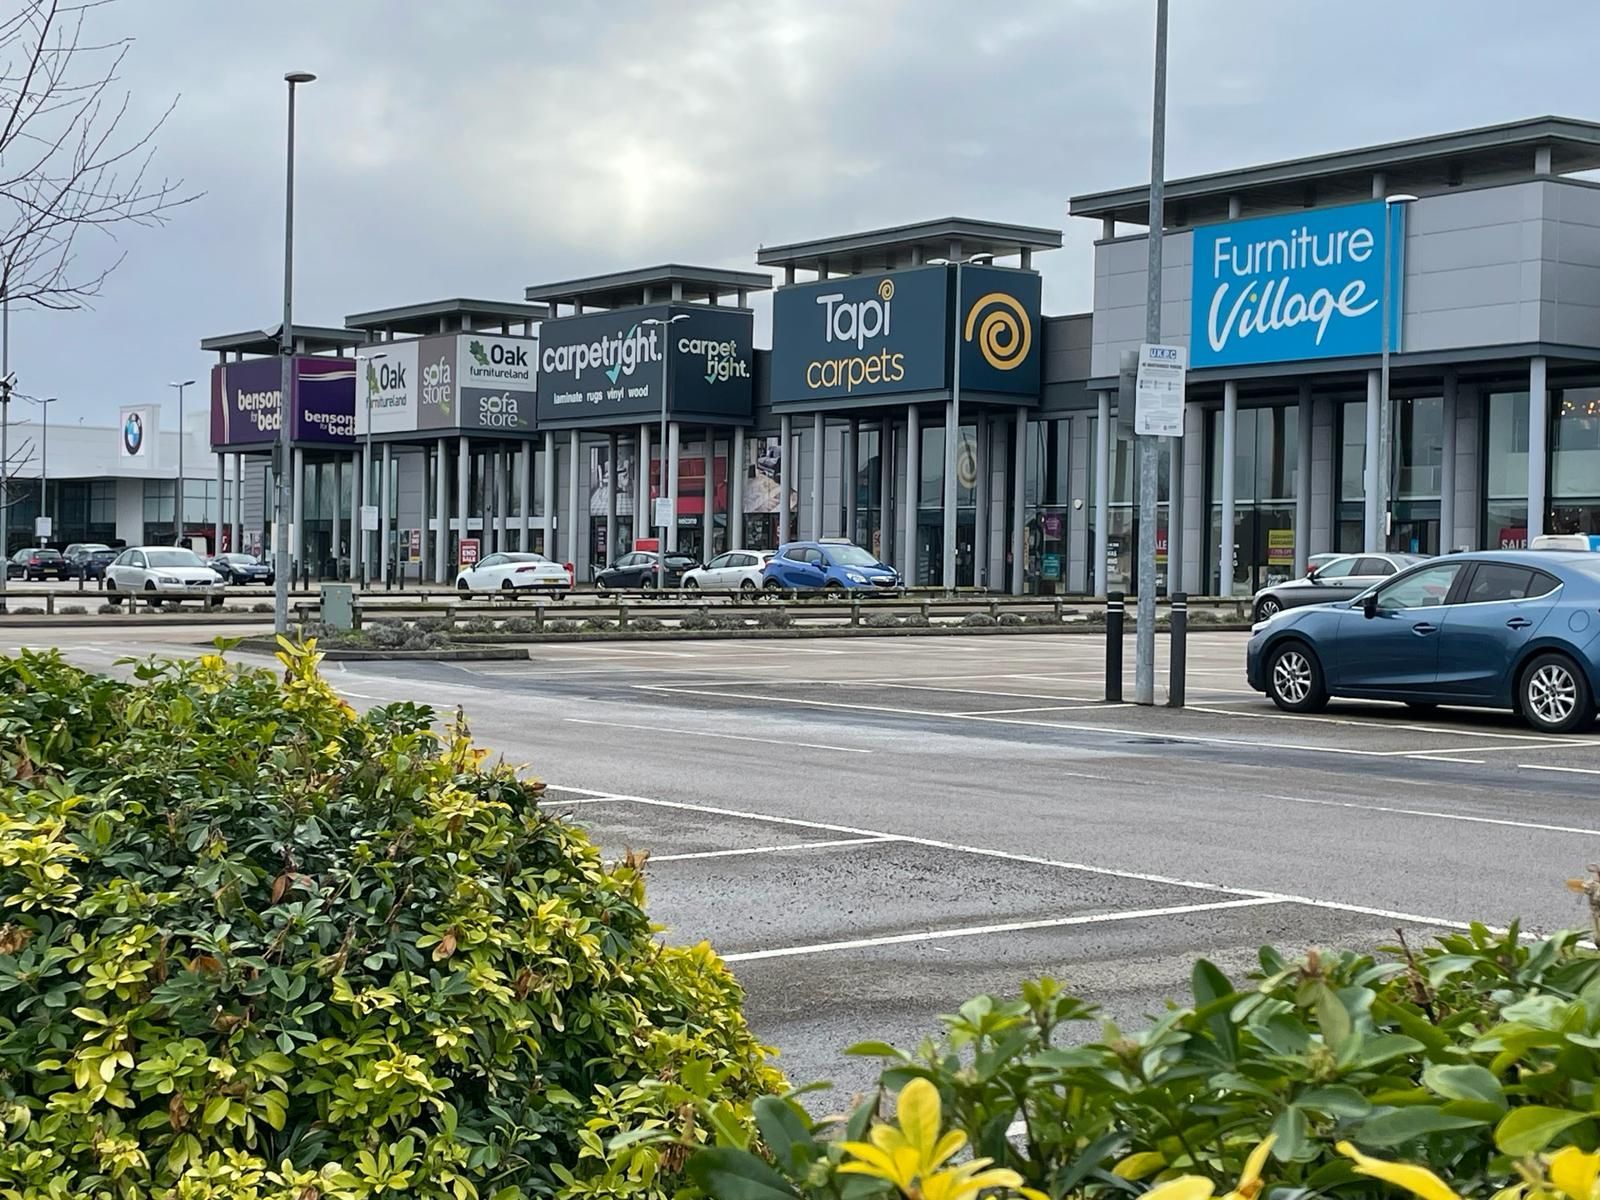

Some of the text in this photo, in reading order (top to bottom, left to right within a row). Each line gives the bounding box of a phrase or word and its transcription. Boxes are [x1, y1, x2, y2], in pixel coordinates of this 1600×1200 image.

[1213, 226, 1375, 279] Furniture
[816, 279, 895, 351] Tapi
[1208, 276, 1379, 352] Village
[490, 344, 529, 367] Oak
[678, 338, 737, 361] carpet
[1150, 348, 1176, 359] UKPC
[380, 362, 406, 391] Oak
[423, 356, 451, 386] sofa
[469, 366, 529, 380] furnitureland
[807, 347, 905, 393] carpets
[237, 388, 282, 411] benson
[366, 393, 407, 408] frnitureland
[422, 383, 451, 405] store
[479, 392, 519, 414] sofa
[553, 384, 649, 405] laminate rugs vinyl wood
[257, 409, 282, 432] bed
[479, 412, 518, 428] store
[1501, 539, 1527, 549] SALE
